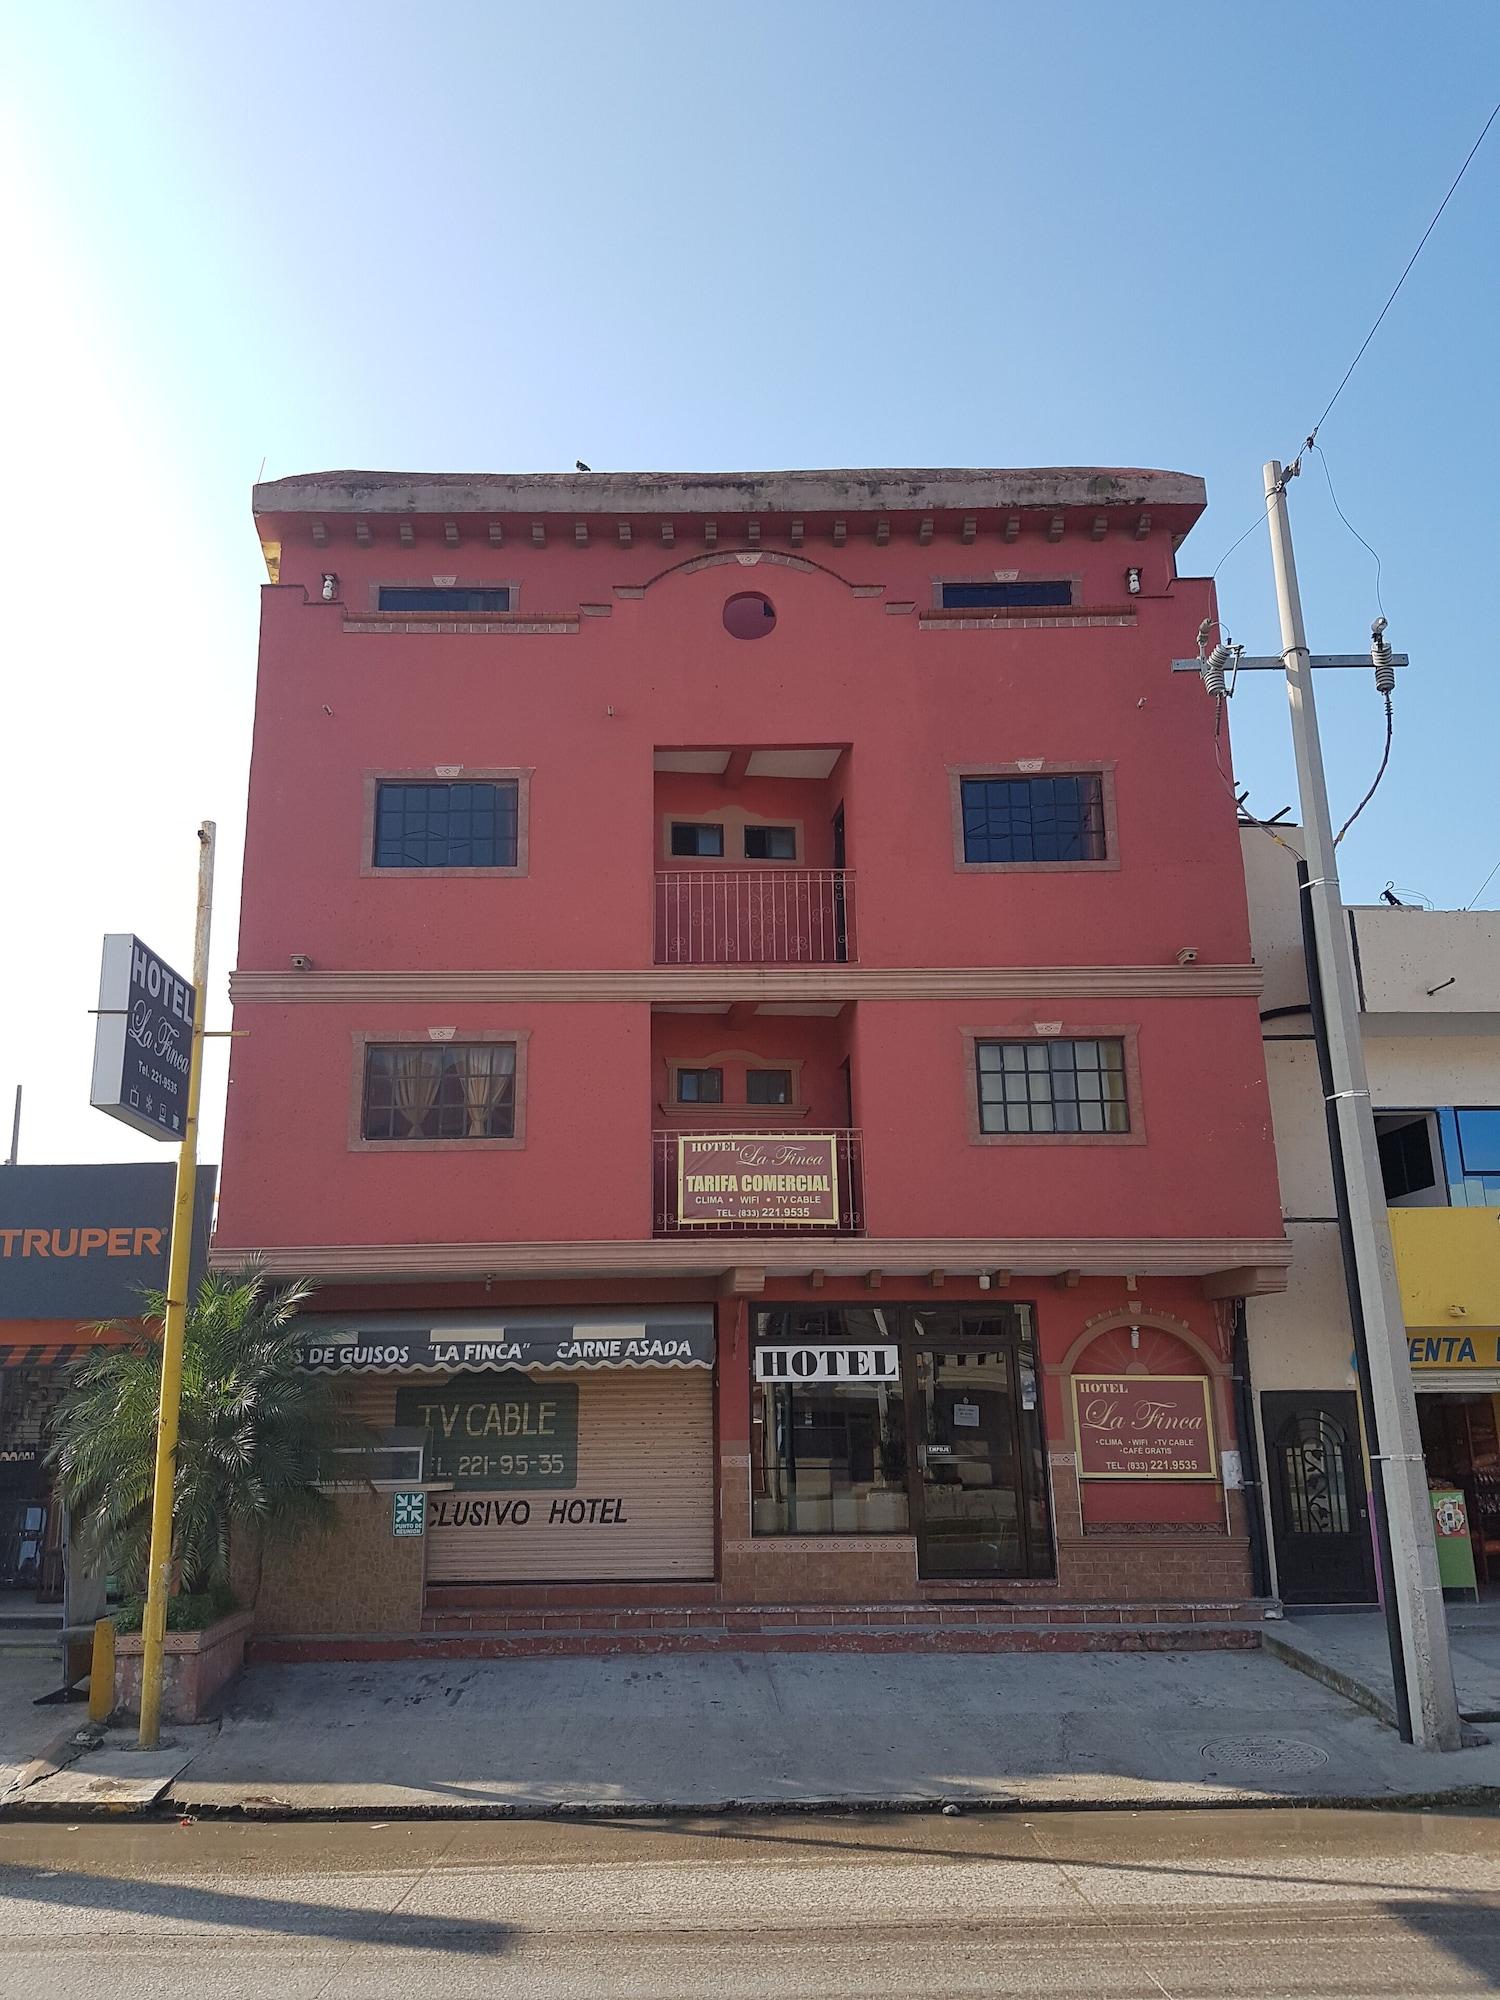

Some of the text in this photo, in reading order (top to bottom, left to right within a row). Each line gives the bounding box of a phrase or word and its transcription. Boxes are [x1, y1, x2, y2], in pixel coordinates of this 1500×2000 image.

[133, 946, 192, 1027] HOTEL
[128, 1000, 189, 1075] La Finca
[138, 1060, 178, 1095] Tel. 221-9535
[691, 1141, 824, 1167] HOTEL La Finca
[686, 1174, 830, 1192] TARIFA COMERCIAL
[695, 1196, 821, 1204] CLIMA WIFI TV CABLE
[716, 1208, 810, 1218] TEL. (833) 221.9535
[309, 1346, 336, 1364] DE
[340, 1345, 409, 1364] GUISOS
[556, 1341, 621, 1358] CARNE
[625, 1339, 692, 1357] ASADA
[1407, 1336, 1476, 1362] ENTA
[760, 1350, 896, 1377] HOTEL
[1080, 1383, 1129, 1393] HOTEL
[417, 1402, 557, 1437] TV CABLE
[1082, 1399, 1204, 1431] La Finca
[1169, 1438, 1194, 1446] CABLE
[457, 1454, 565, 1476] 221-95-35
[1106, 1460, 1198, 1471] TEL. (833) 221.9535
[549, 1498, 628, 1524] HOTEL
